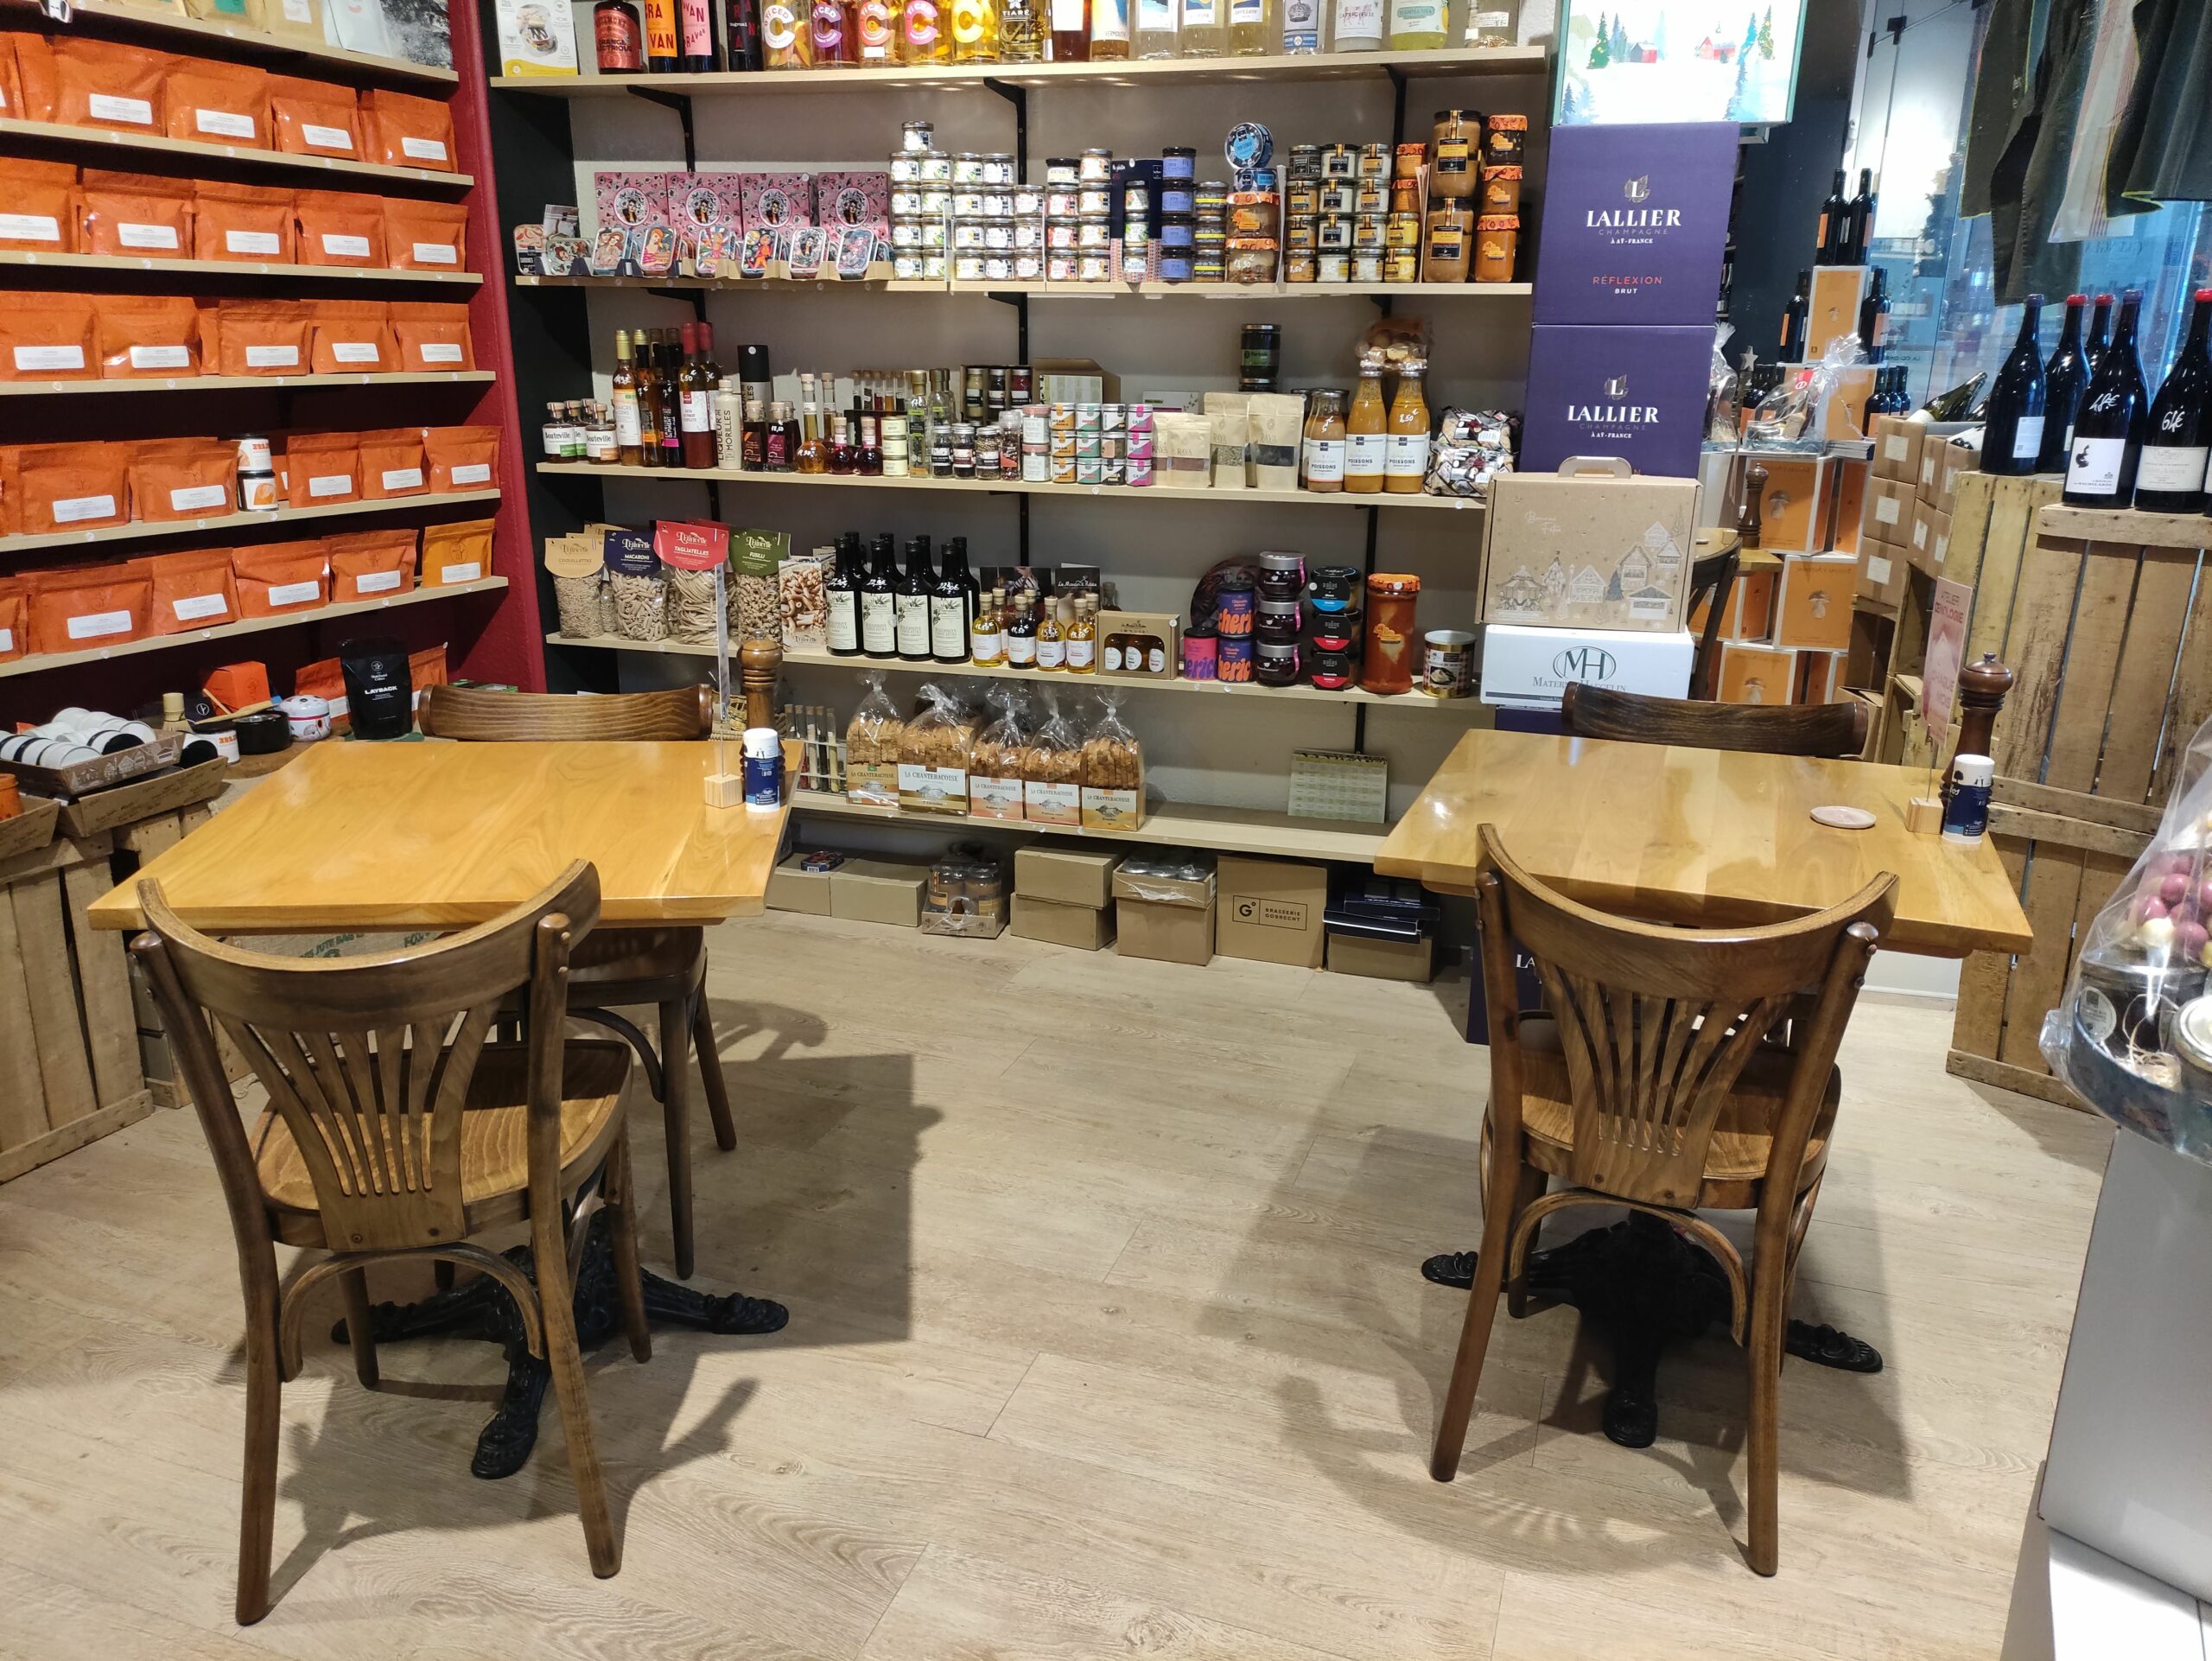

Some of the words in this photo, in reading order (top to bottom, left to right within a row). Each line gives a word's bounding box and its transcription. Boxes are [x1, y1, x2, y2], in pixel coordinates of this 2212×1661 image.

[650, 34, 674, 48] VAN
[1631, 181, 1644, 198] L
[1586, 209, 1681, 226] LALLIER
[1592, 275, 1662, 284] RÉFLEXION
[1611, 379, 1624, 395] L
[1567, 404, 1660, 423] LALLIER
[724, 410, 733, 450] MORILLES
[674, 546, 709, 556] TAGLIATELLES
[1564, 648, 1605, 680] MH
[365, 685, 397, 695] LAYBACK
[912, 773, 958, 782] CHANTERACOISE
[1265, 907, 1300, 916] BRASSERIE
[1265, 913, 1300, 922] GOBRECHT
